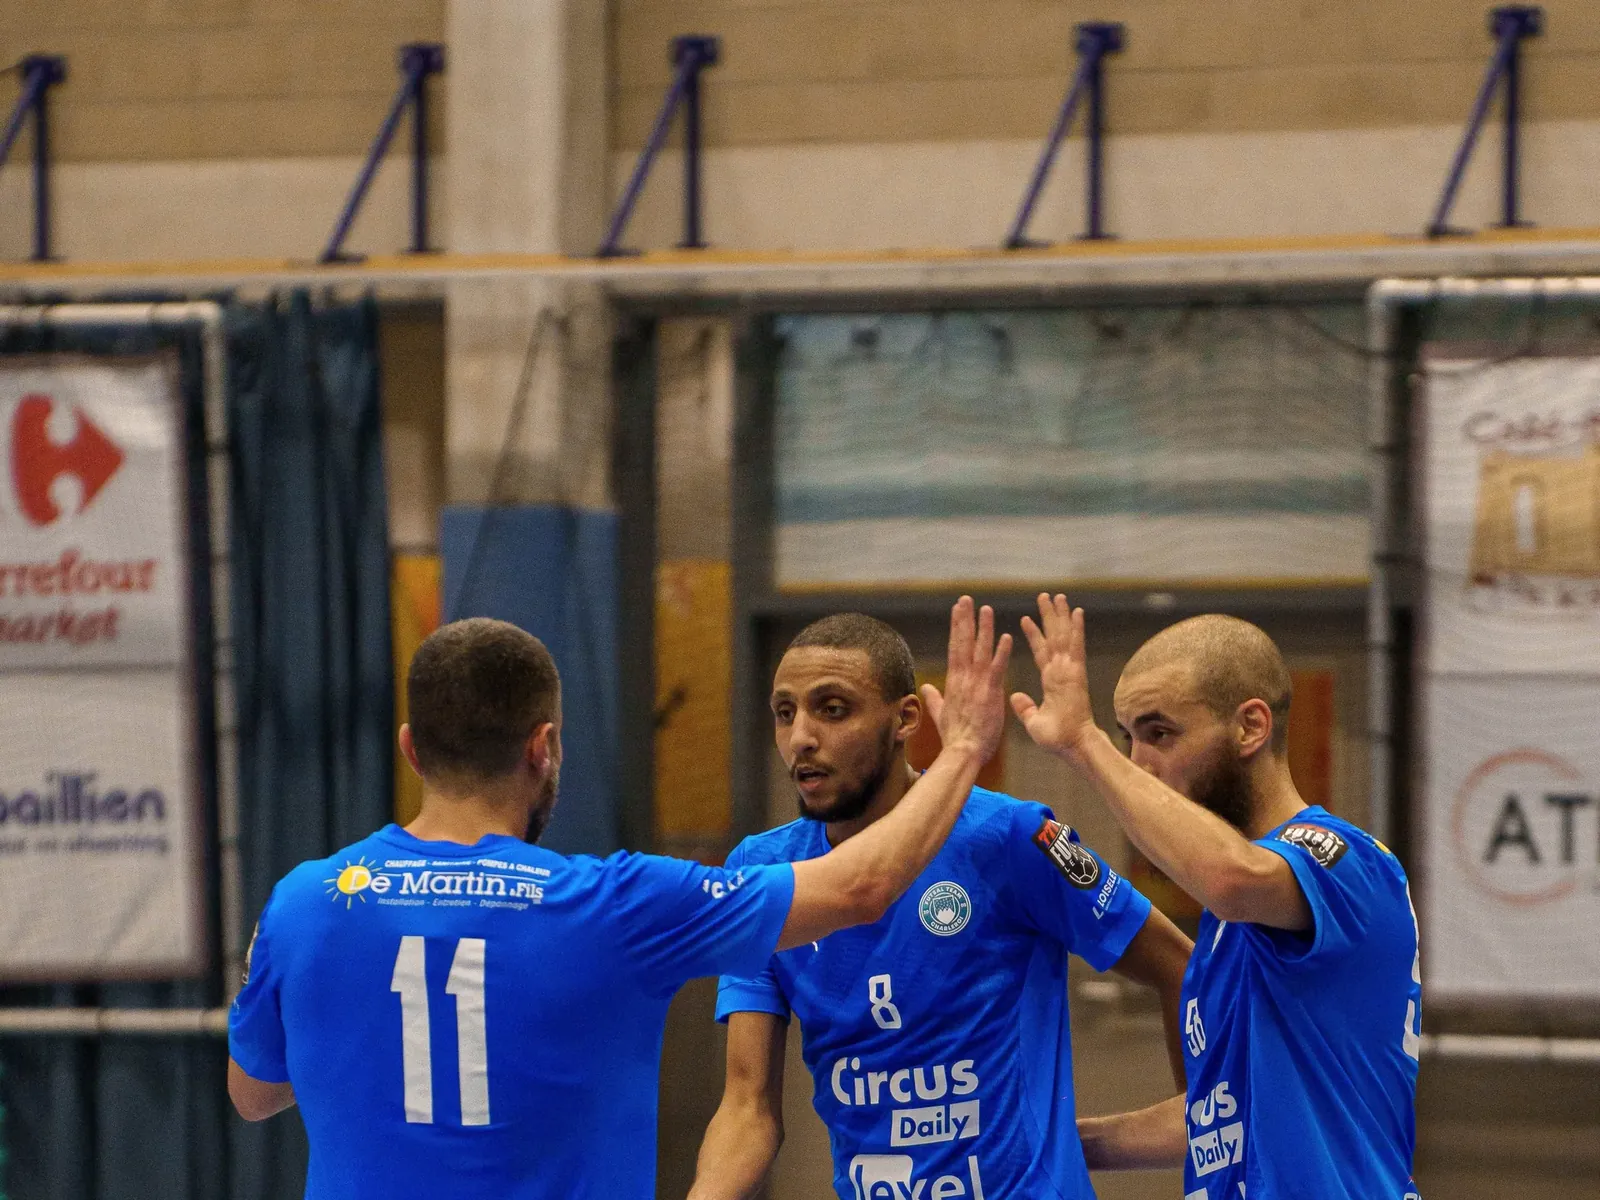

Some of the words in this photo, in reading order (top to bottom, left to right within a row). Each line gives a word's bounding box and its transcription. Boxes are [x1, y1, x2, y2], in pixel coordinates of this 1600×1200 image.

[347, 870, 392, 893] De
[399, 871, 506, 895] Martin
[869, 974, 901, 1029] 8
[390, 936, 490, 1125] 11
[831, 1057, 979, 1105] Circus
[900, 1111, 971, 1140] Daily
[1195, 1133, 1238, 1168] Daily
